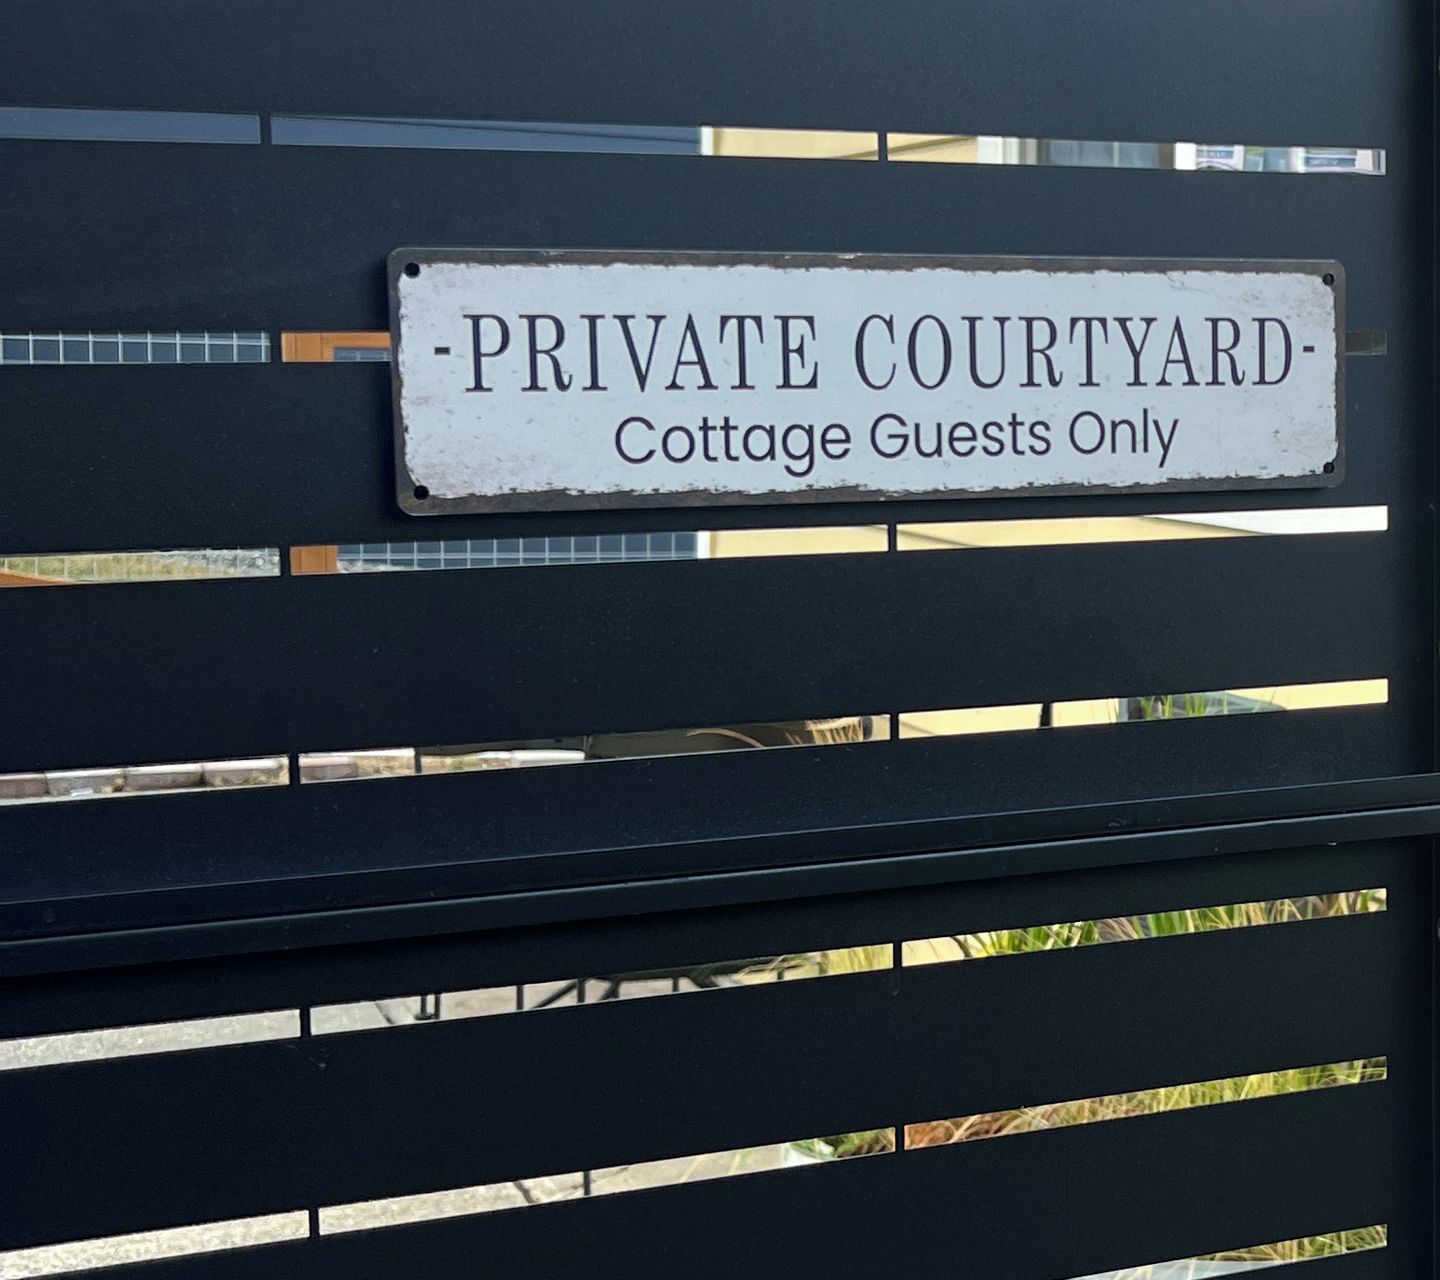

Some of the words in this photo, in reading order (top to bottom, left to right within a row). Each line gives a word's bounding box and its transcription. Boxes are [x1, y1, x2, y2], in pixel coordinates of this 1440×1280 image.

[614, 413, 851, 477] Cottage
[869, 411, 1052, 461] Guests
[1068, 408, 1180, 468] Only
